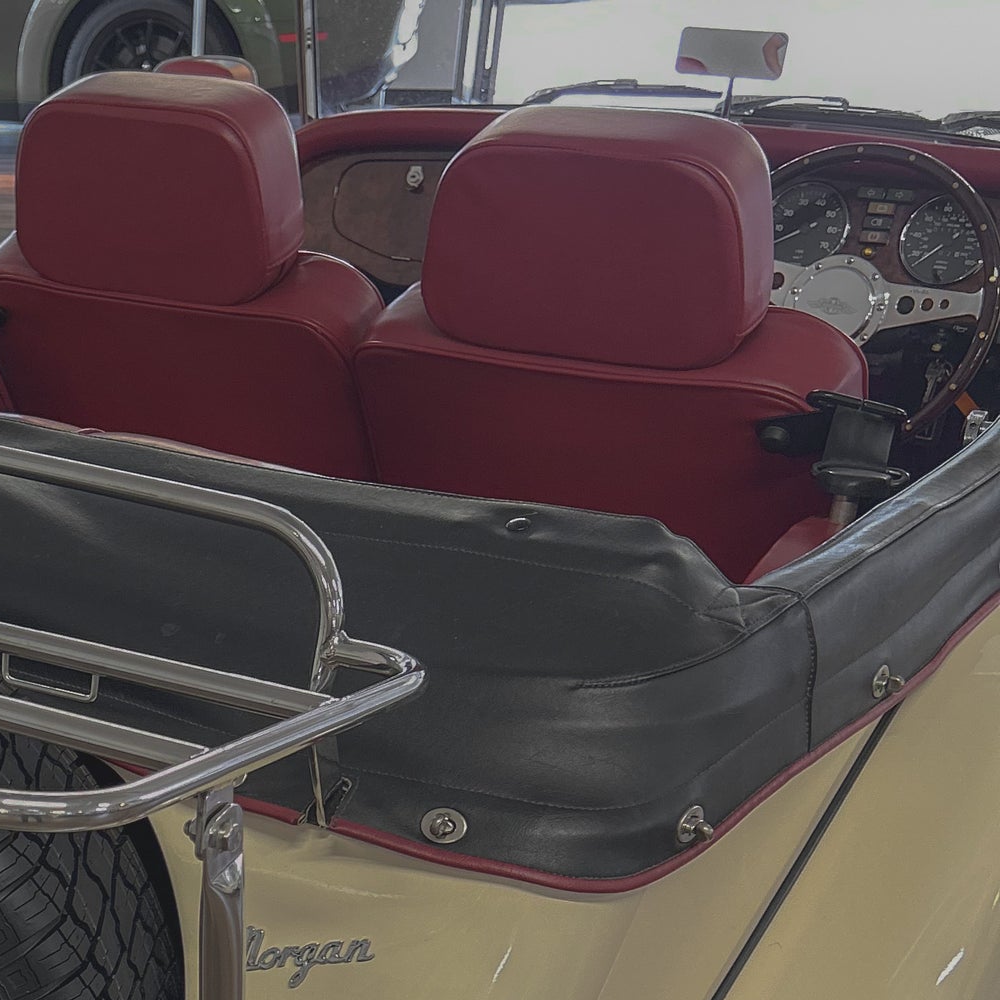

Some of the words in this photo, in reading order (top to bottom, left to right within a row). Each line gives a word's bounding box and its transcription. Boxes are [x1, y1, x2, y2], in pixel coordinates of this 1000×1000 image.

[783, 209, 794, 217] 20
[825, 210, 837, 218] 50
[775, 224, 784, 232] 10
[826, 226, 838, 234] 60
[819, 241, 830, 249] 70
